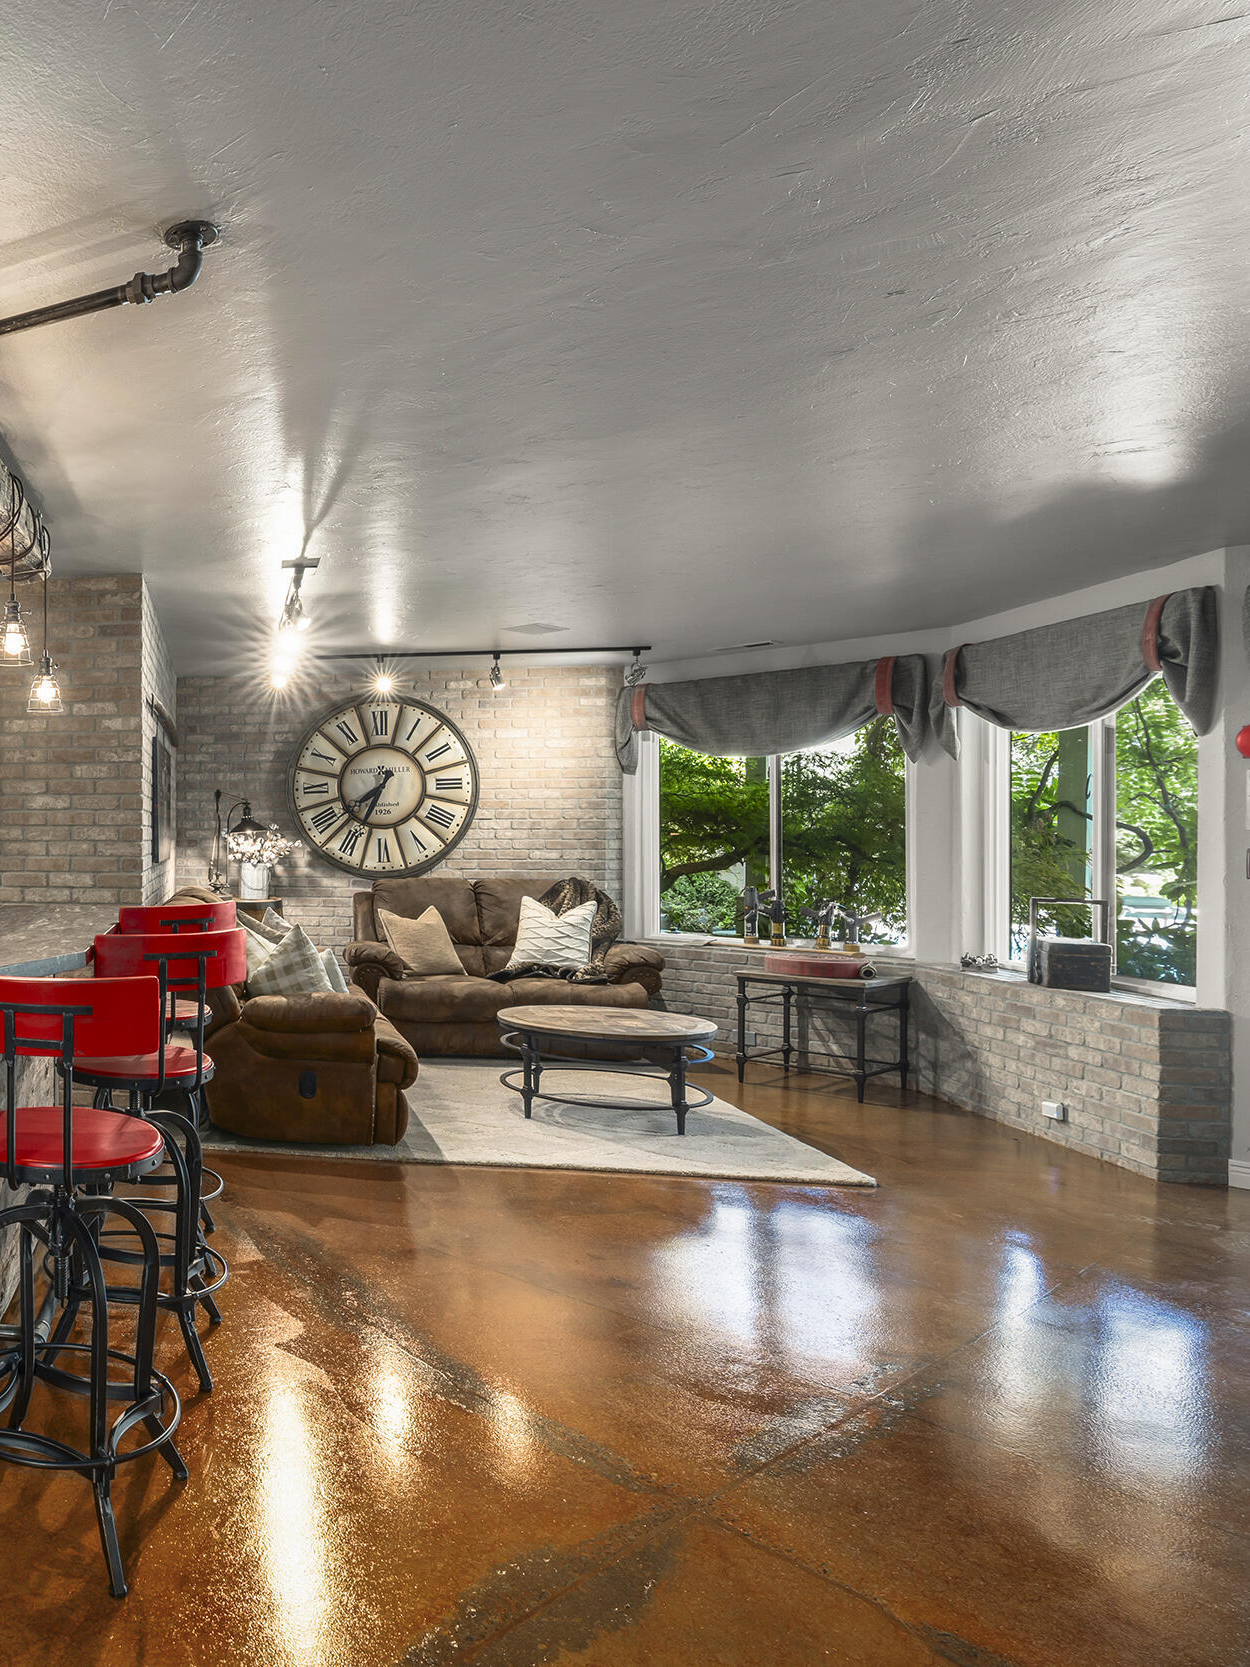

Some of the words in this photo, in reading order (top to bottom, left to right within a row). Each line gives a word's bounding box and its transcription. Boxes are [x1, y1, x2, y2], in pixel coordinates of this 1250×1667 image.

[336, 720, 359, 746] XI
[370, 710, 389, 736] XII
[310, 748, 337, 767] X
[425, 742, 452, 762] II
[385, 766, 411, 774] MILLER
[303, 782, 329, 795] IX
[435, 777, 463, 791] III
[311, 806, 340, 835] VIII
[425, 804, 456, 829] IIII
[377, 838, 391, 863] VI
[410, 830, 428, 853] V
